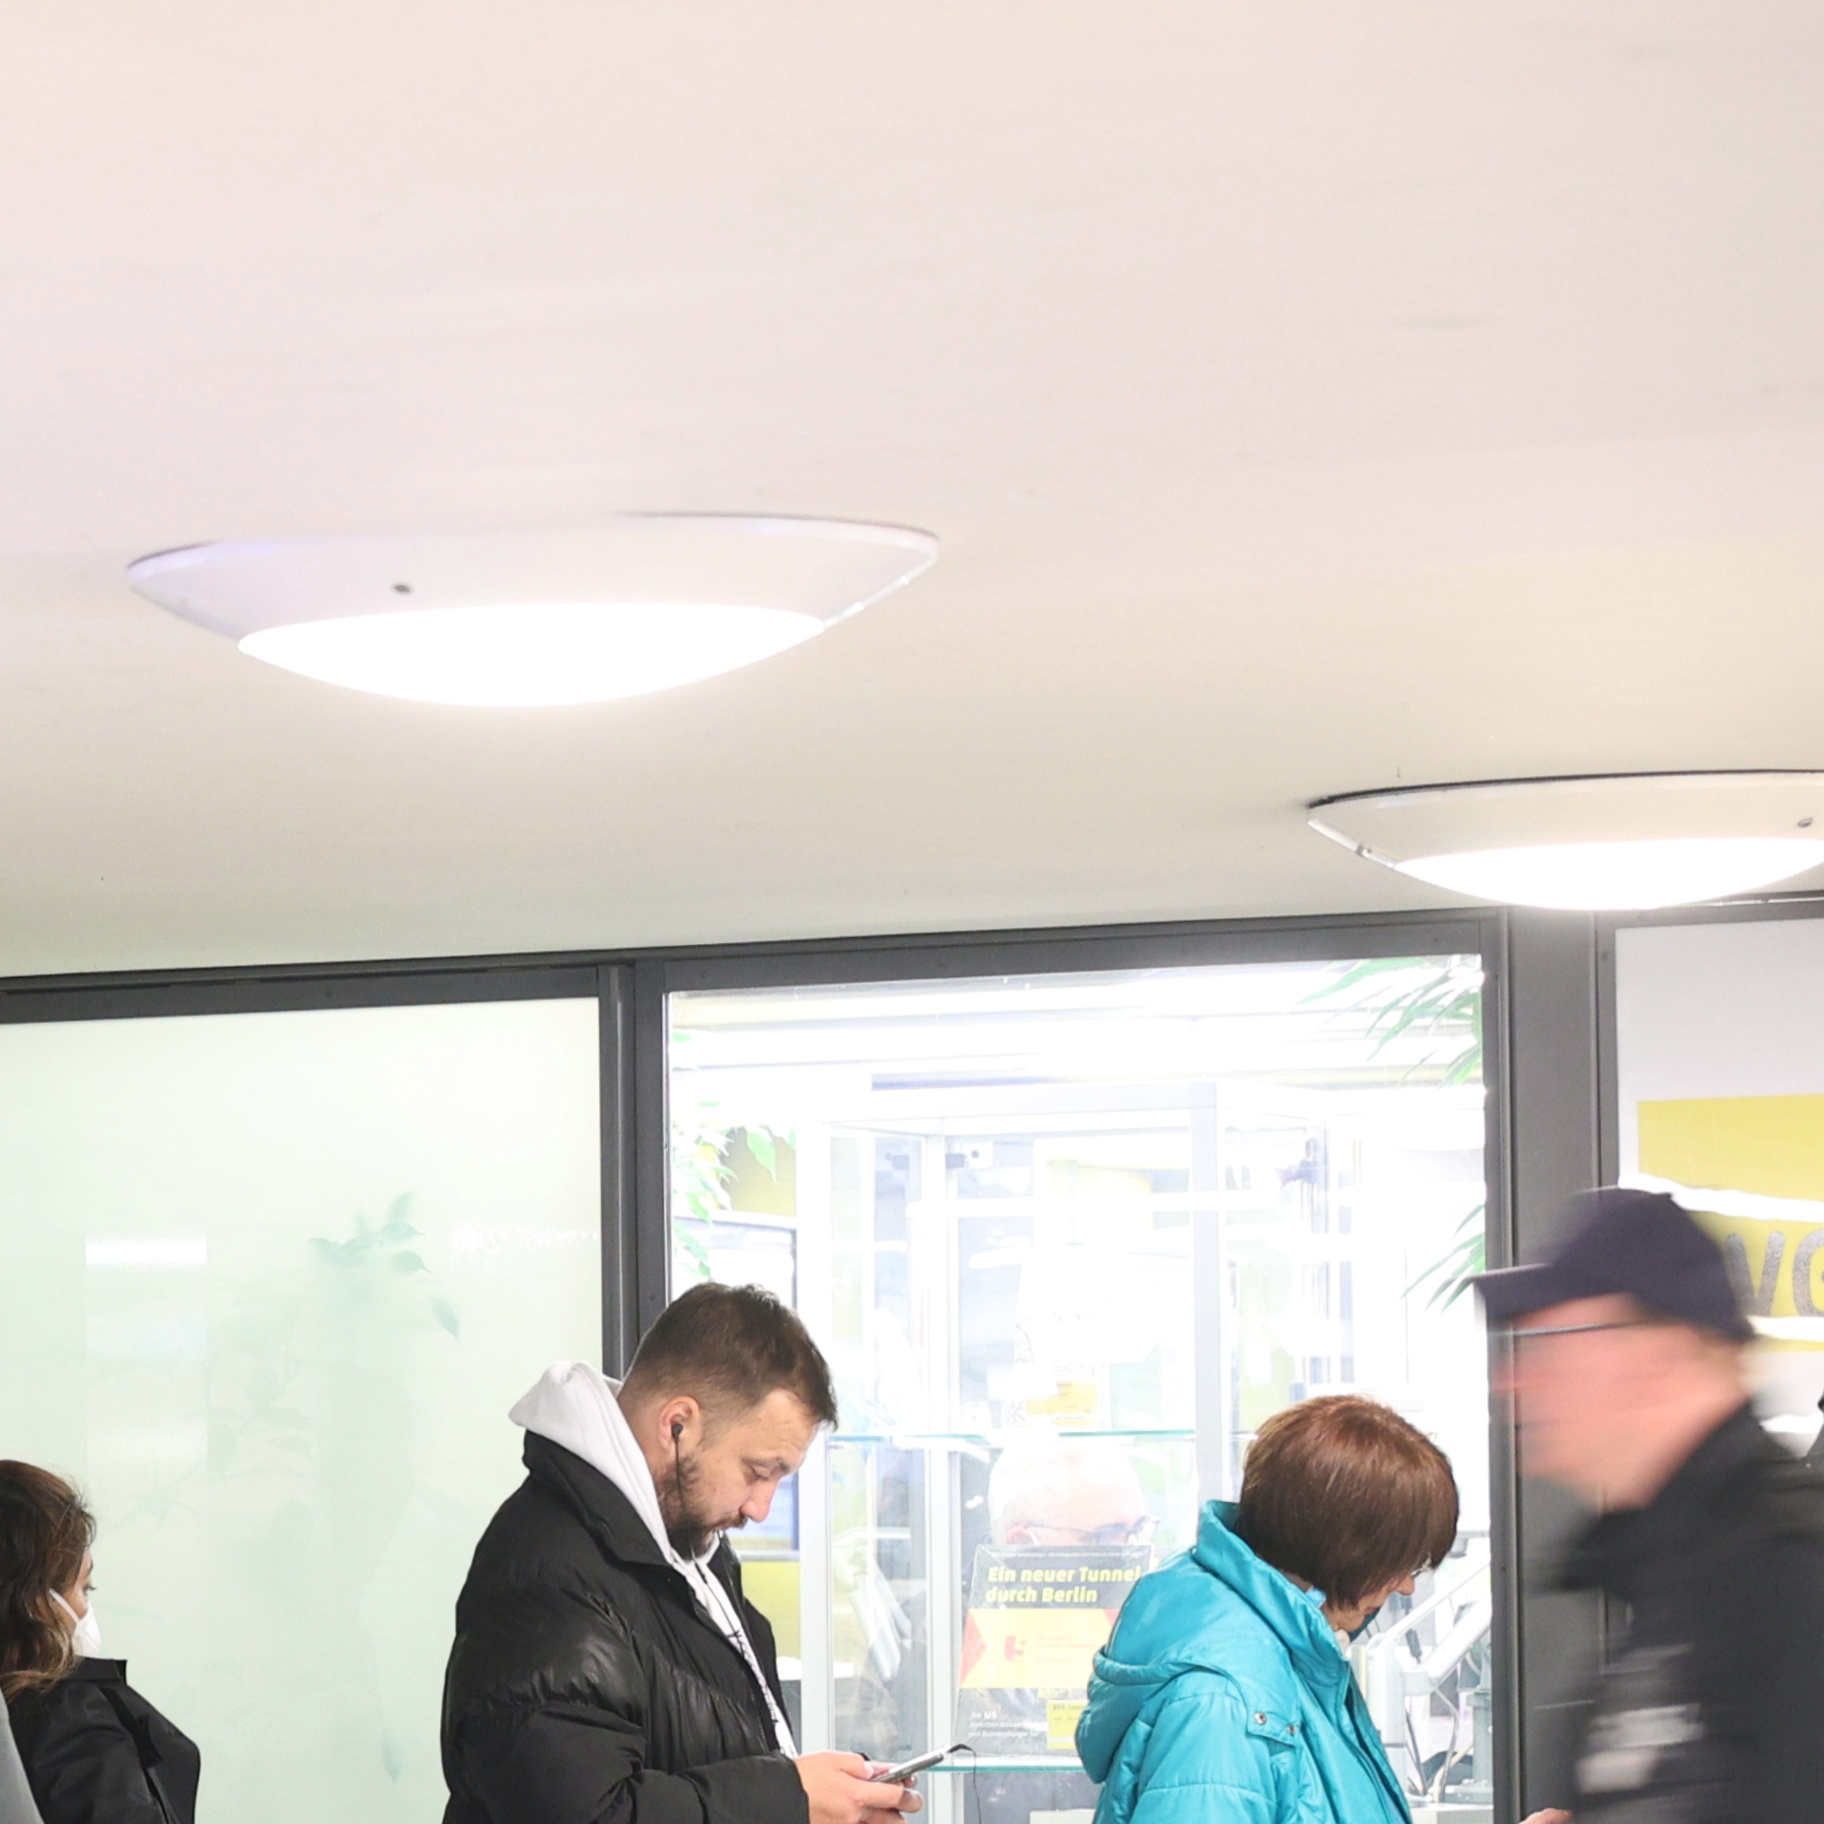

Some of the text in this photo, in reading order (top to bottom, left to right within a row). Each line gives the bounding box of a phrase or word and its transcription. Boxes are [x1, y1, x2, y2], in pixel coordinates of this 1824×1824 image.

[987, 1565, 1142, 1583] Ein neuer Tunnel
[985, 1586, 1098, 1603] durch Berlin
